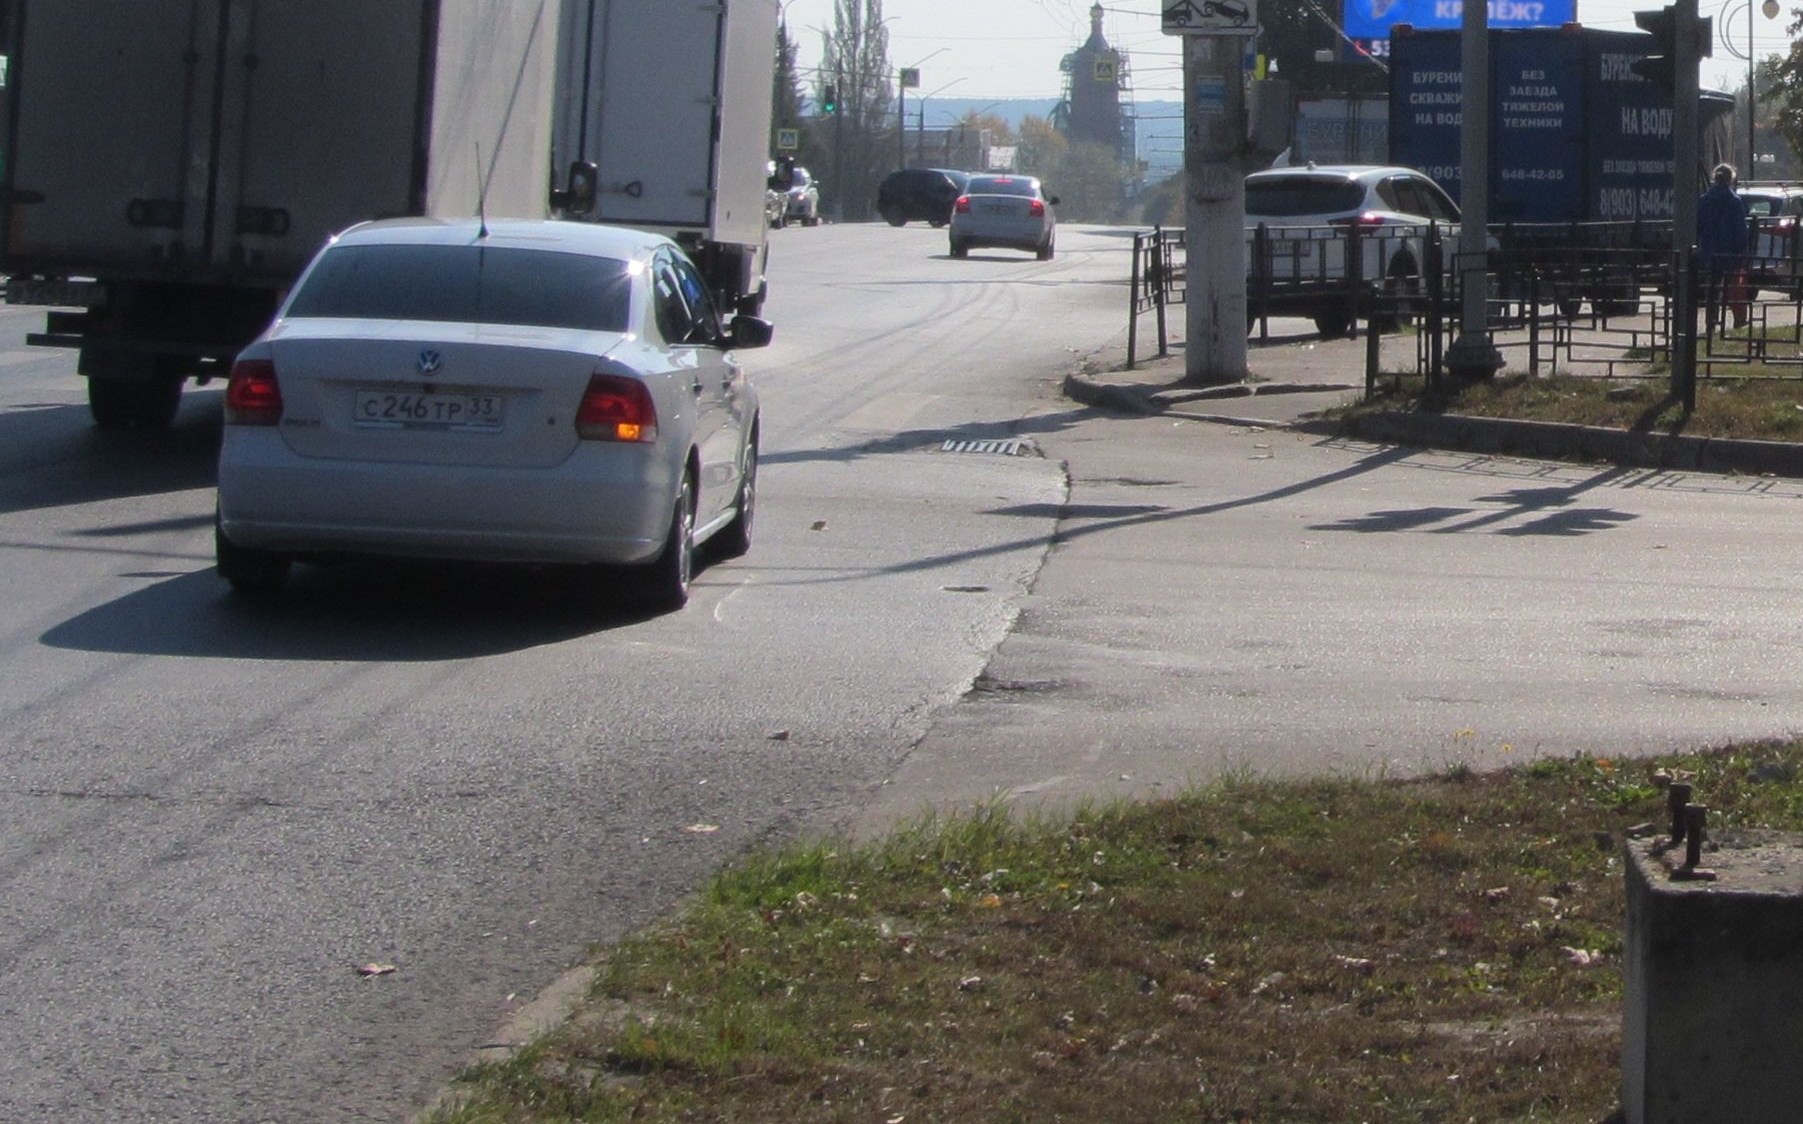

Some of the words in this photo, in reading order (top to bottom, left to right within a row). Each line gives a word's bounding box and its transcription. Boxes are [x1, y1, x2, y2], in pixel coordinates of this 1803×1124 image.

[1412, 71, 1463, 84] БУРЕНИ
[1520, 69, 1546, 80] БЕЗ
[1509, 85, 1558, 98] ЗАЕЗДА
[1410, 92, 1463, 105] СКВАЖИ
[1502, 99, 1565, 113] ТЯЖЕЛОЙ
[1415, 113, 1433, 125] НА
[1437, 112, 1463, 126] ВОД
[1503, 117, 1563, 128] ТЕХНИКИ
[1621, 107, 1639, 135] НА
[1641, 108, 1674, 140] ВОДУ
[1640, 188, 1675, 215] 648-42
